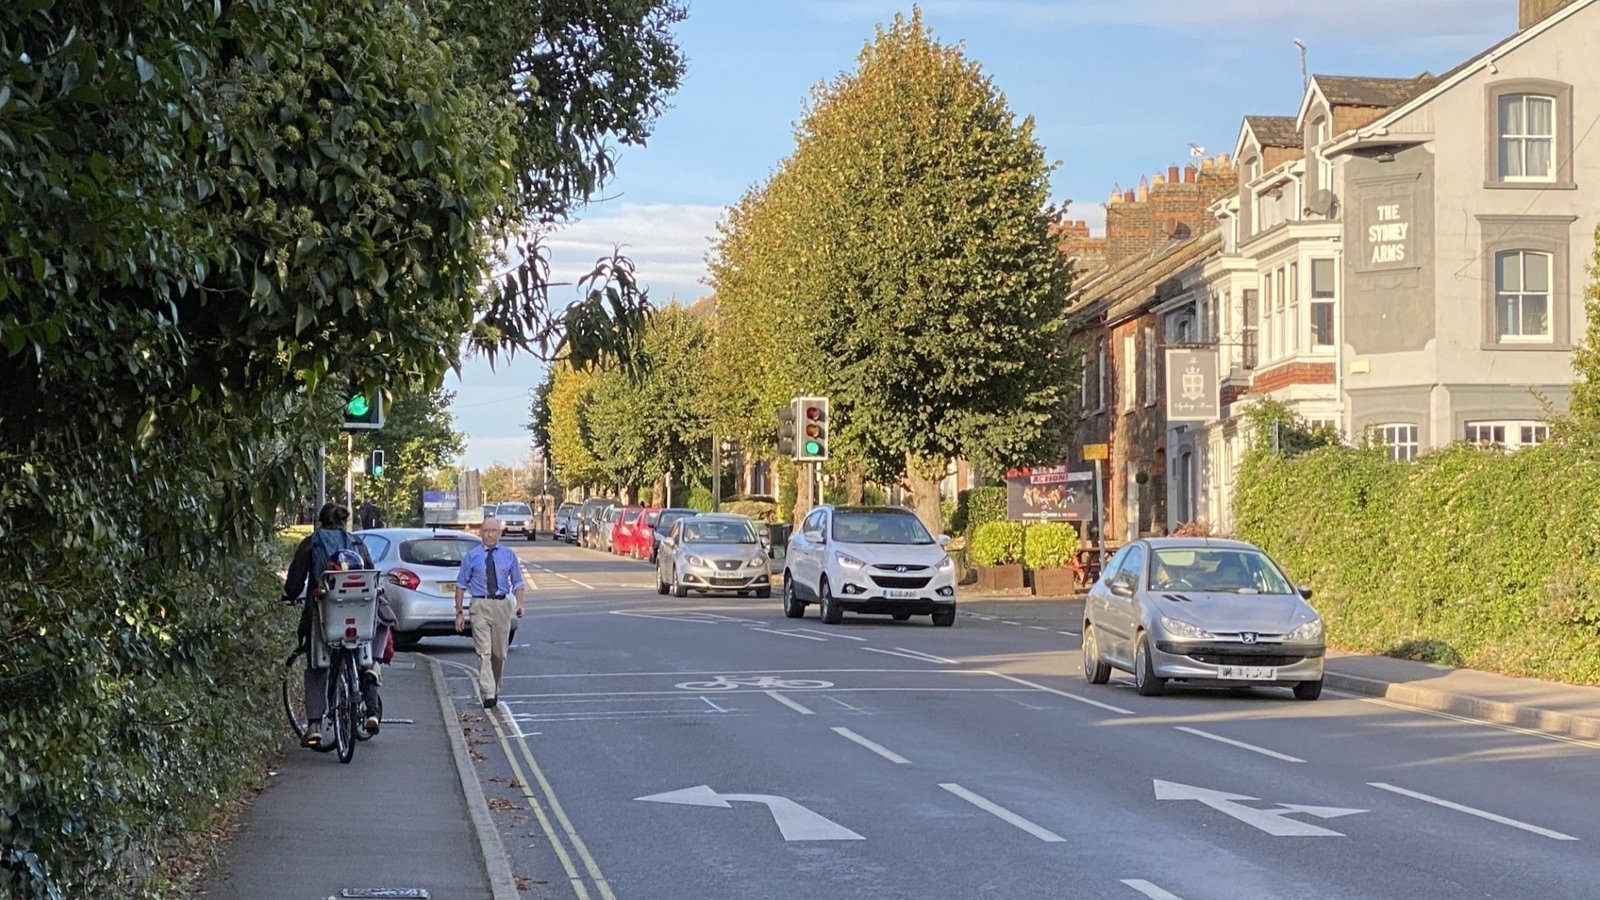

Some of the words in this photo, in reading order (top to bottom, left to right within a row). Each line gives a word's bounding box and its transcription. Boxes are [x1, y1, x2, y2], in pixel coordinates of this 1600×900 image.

[1377, 204, 1400, 221] THE
[1368, 222, 1408, 242] SYDNEY
[1371, 243, 1405, 263] ARMS
[1033, 473, 1068, 483] ACTION!
